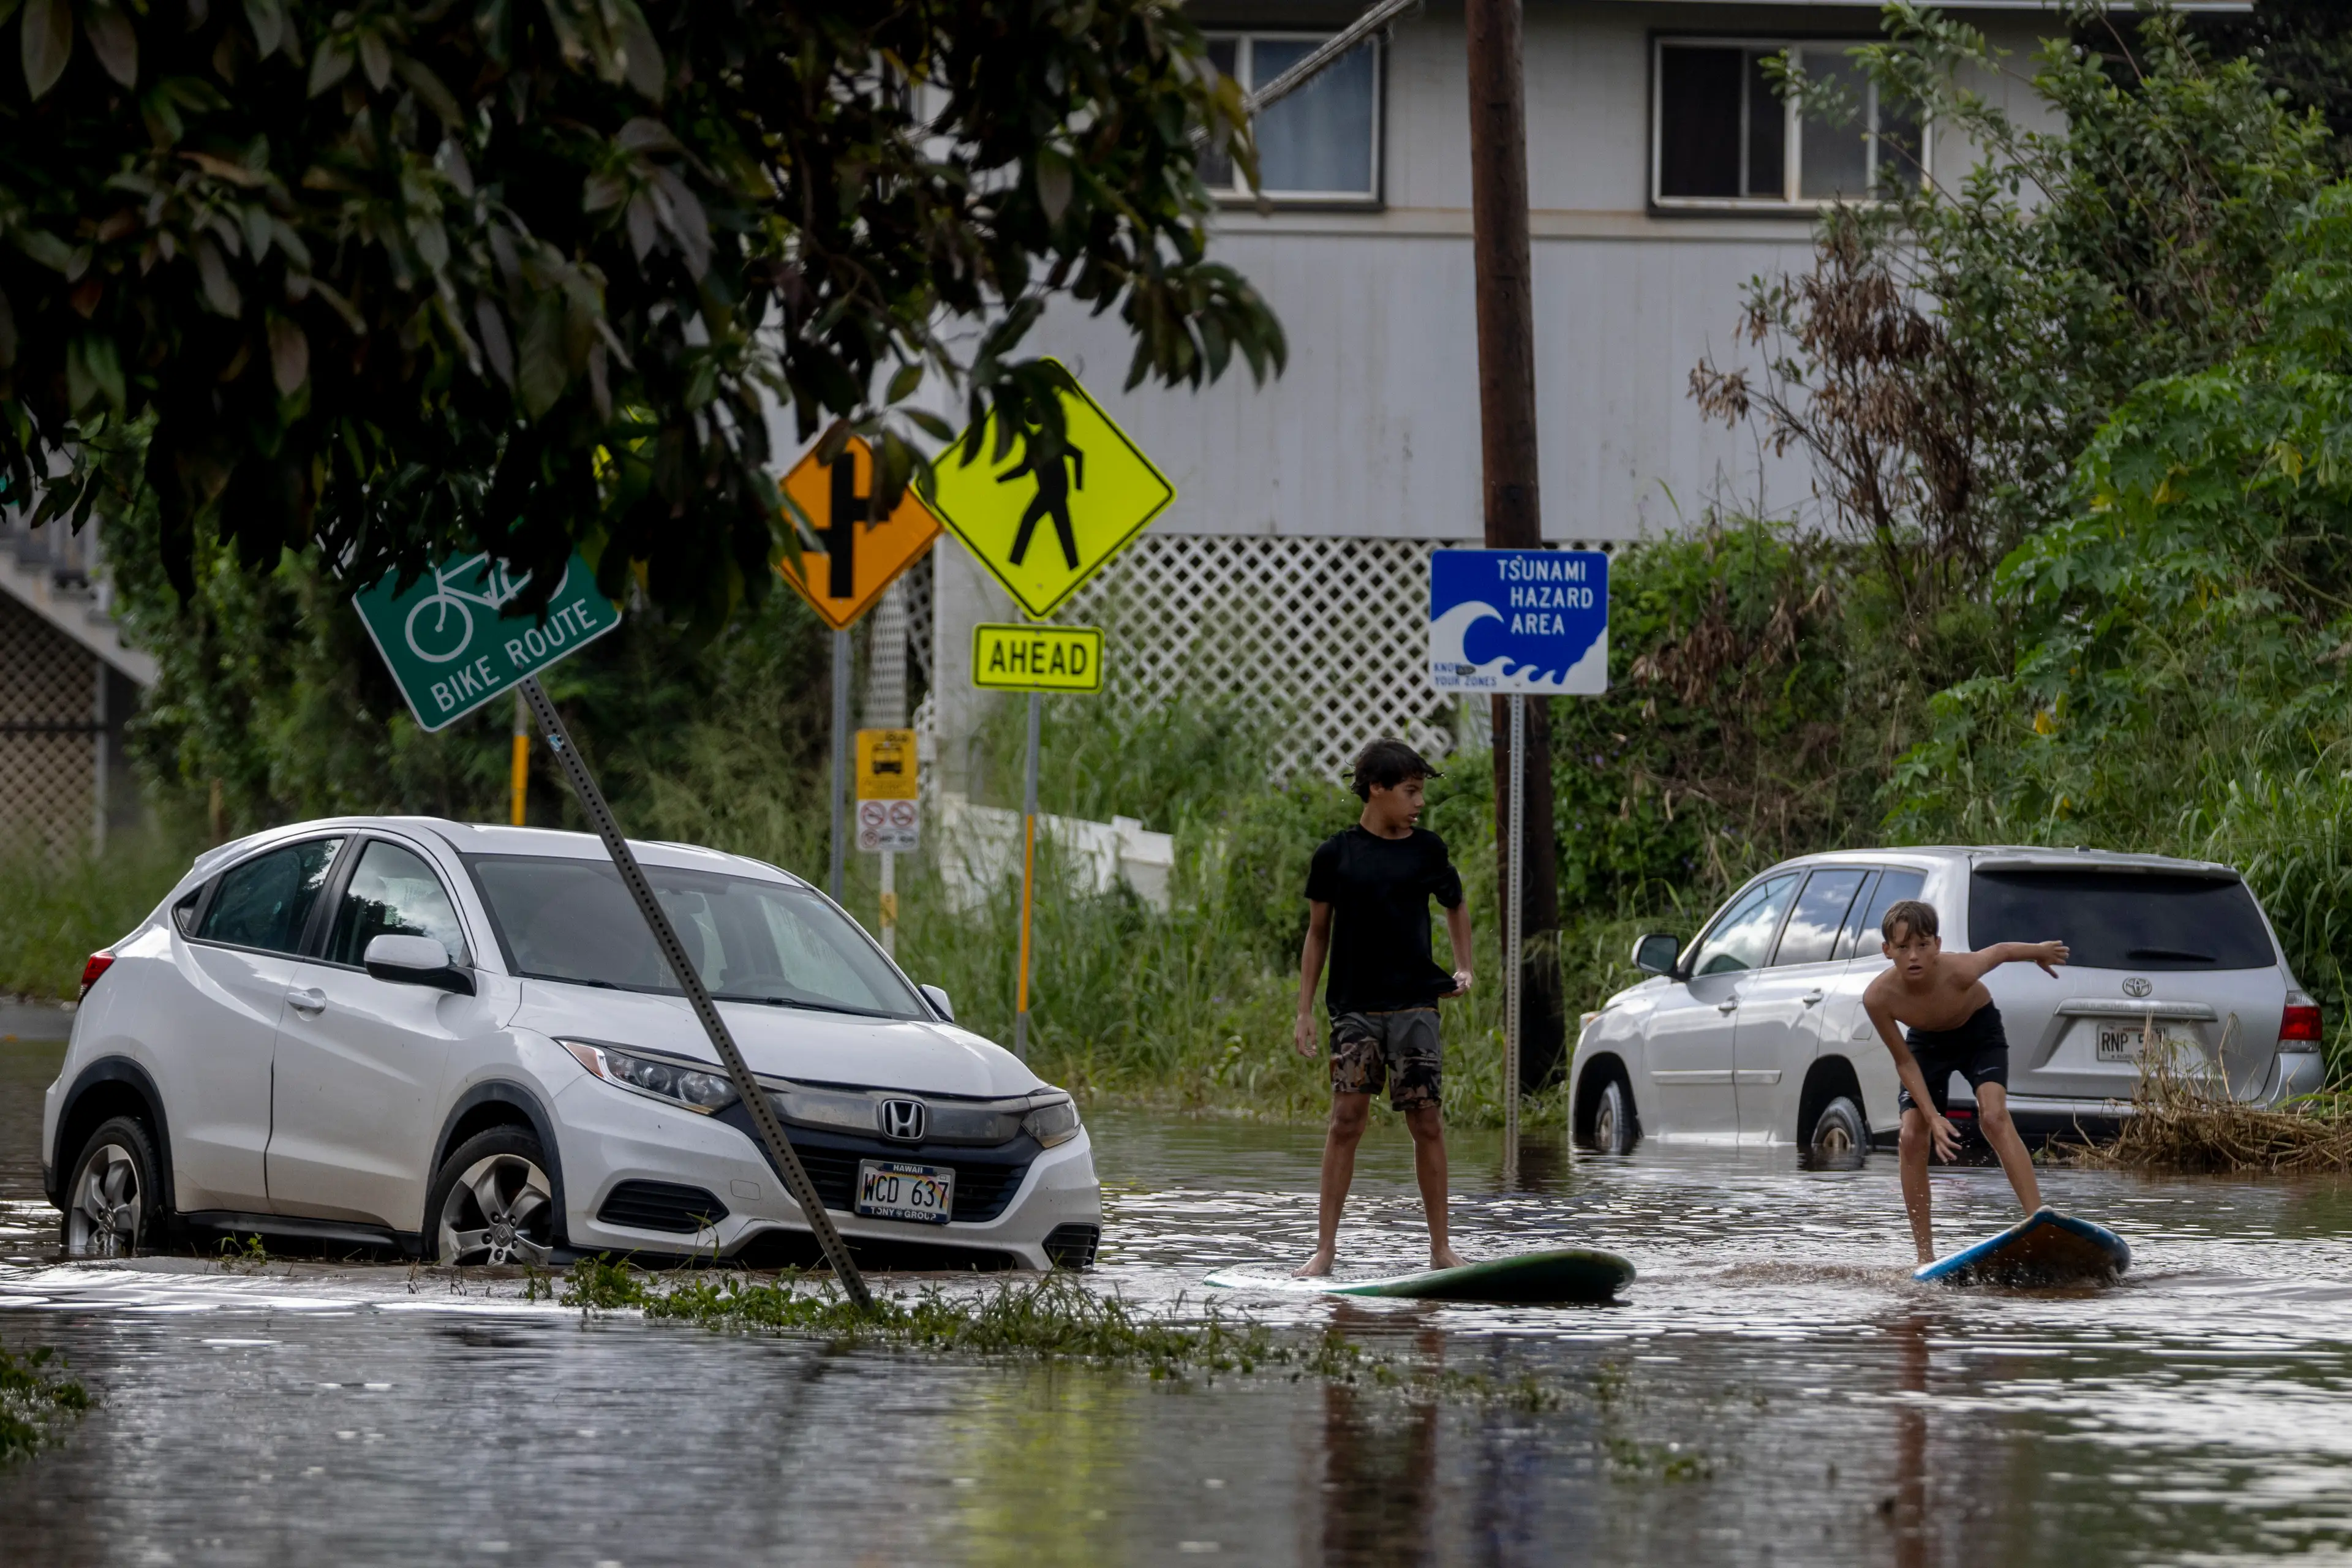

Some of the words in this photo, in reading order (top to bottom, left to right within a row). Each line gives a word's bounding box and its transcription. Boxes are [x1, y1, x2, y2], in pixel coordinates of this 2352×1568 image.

[1497, 559, 1586, 581] TSUNAMI
[1510, 586, 1594, 609] HAZARD
[1510, 612, 1565, 636] AREA
[430, 655, 501, 712] BIKE
[504, 598, 597, 667] ROUTE
[988, 639, 1088, 676] AHEAD
[1434, 676, 1460, 686] YOUR
[1464, 676, 1497, 687] ZONES
[2101, 1031, 2128, 1052] RNP
[893, 1164, 923, 1174] HAWAII
[863, 1172, 899, 1204] WCD
[911, 1180, 949, 1208] 637
